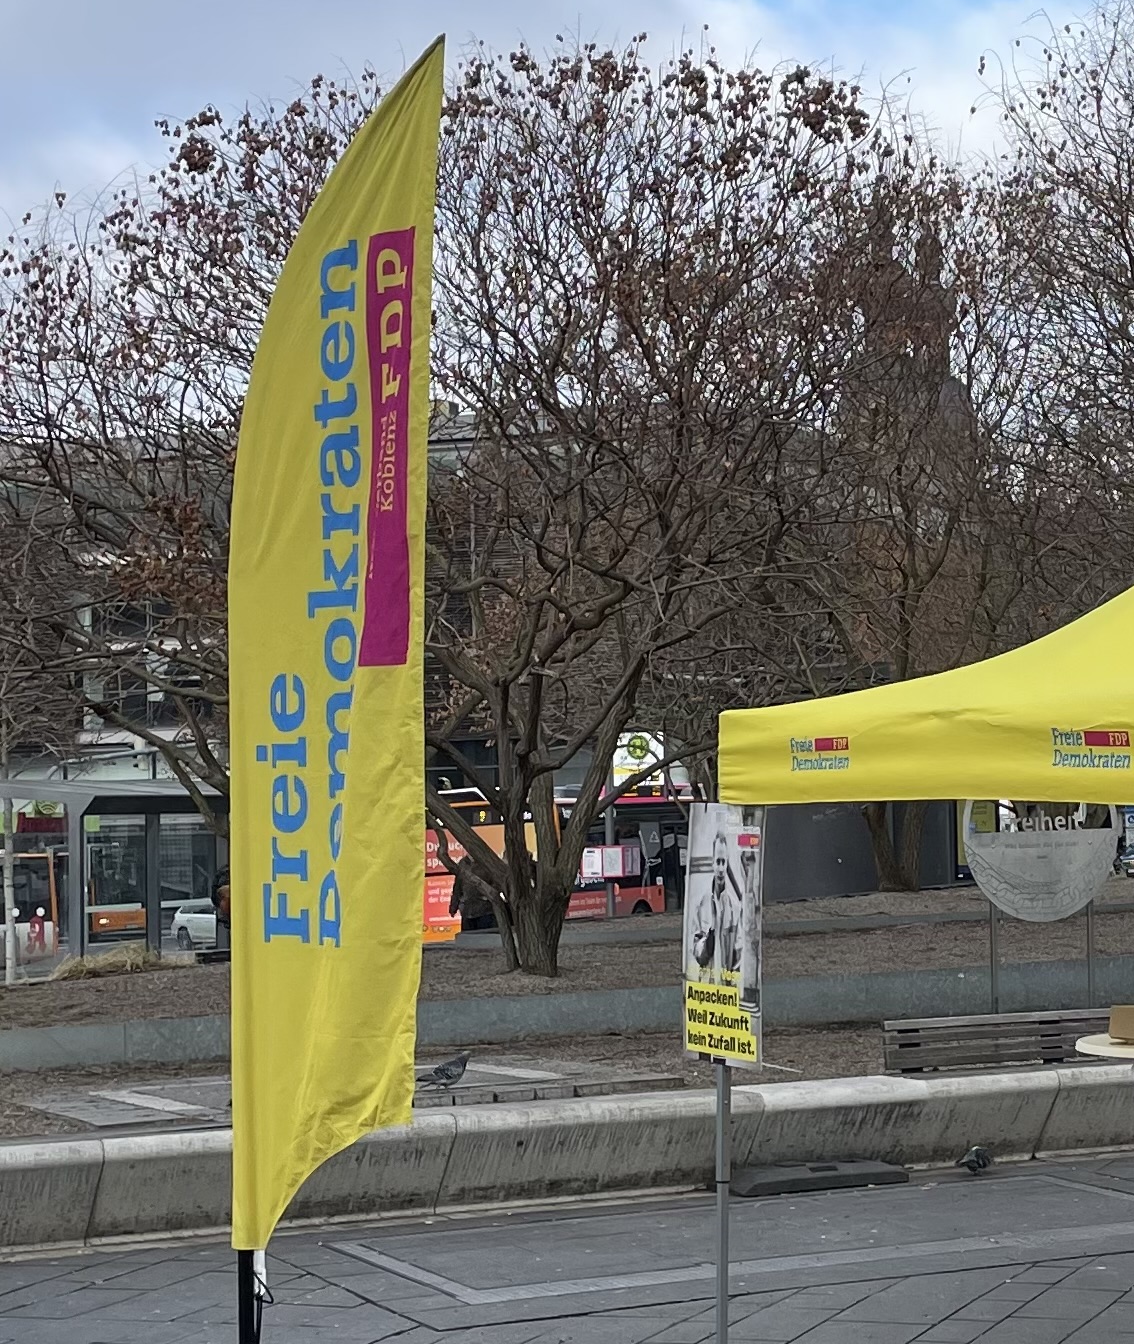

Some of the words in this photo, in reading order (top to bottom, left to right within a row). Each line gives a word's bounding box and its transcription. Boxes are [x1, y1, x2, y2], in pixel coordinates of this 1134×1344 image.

[376, 248, 407, 404] FDP
[380, 410, 397, 512] Koblenz
[832, 738, 848, 750] FDP
[1051, 728, 1083, 746] Freie
[1108, 733, 1128, 745] FDP
[1052, 748, 1131, 768] Demokraten
[256, 672, 310, 945] Freie
[687, 985, 738, 1008] Anpacken!
[687, 1007, 708, 1025] Weil
[708, 1011, 749, 1032] Zukunft
[687, 1029, 707, 1047] kein
[707, 1033, 736, 1053] Zufall
[737, 1038, 755, 1056] ist.
